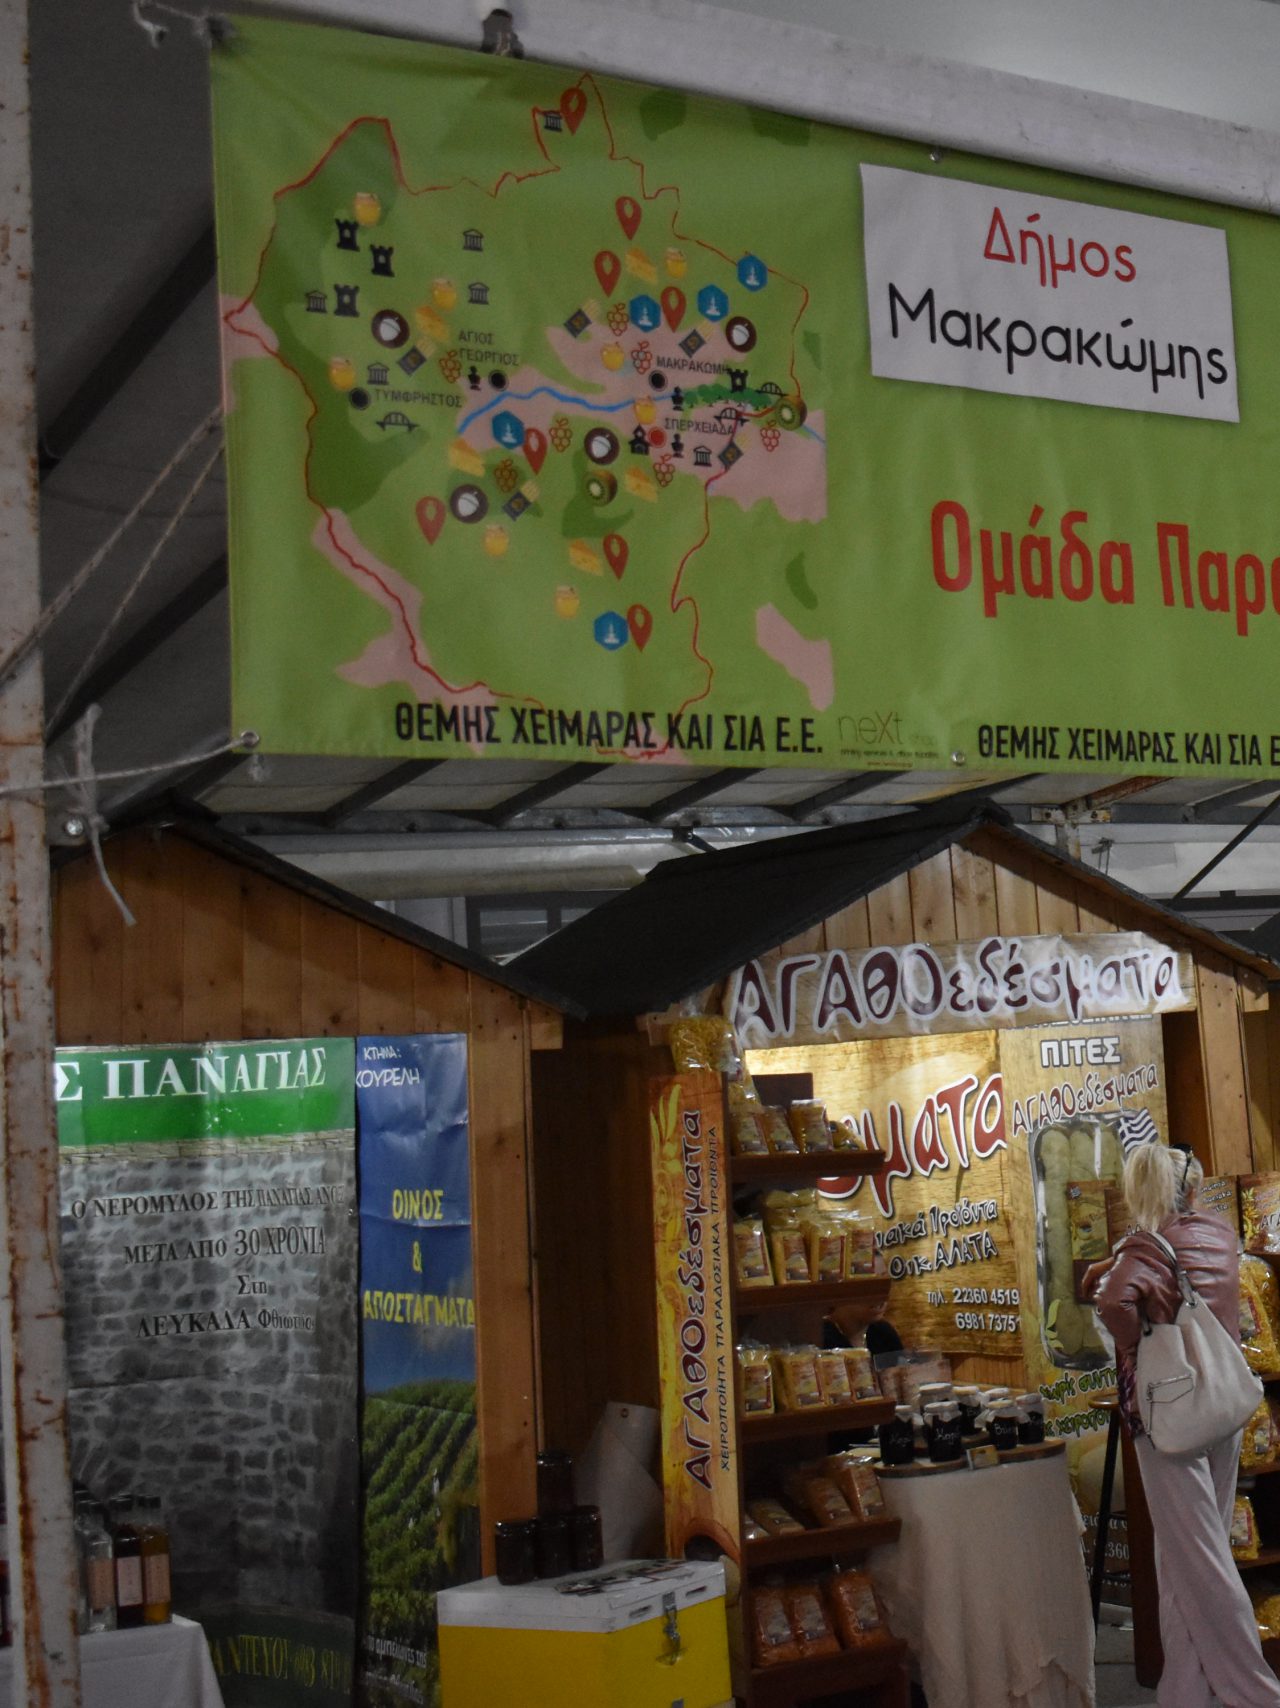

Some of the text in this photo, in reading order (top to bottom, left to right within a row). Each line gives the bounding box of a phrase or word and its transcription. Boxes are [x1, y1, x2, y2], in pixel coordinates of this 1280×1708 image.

[984, 205, 1136, 288] Δήμος
[459, 330, 493, 345] ΑΓΙΟΣ
[889, 282, 1227, 399] Μακρακώμης
[459, 349, 520, 366] ΓΕΩΡΓΙΟΣ
[374, 389, 462, 409] ΤΥΜΦΡΗΣΤΟΣ
[664, 417, 735, 435] ΣΠΕΡΧΕΙΑΔΑ
[930, 500, 1134, 618] Ομάδα
[395, 701, 822, 753] ΘΕΜΗΣ ΧΕΙΜΑΡΑΣ ΚΑΙ ΣΙΑ Ε.Ε.
[979, 725, 1058, 758] ΘΕΜΗΣ
[1068, 727, 1179, 763] ΧΕΙΜΑΡΑΣ
[1186, 732, 1221, 766] ΚΑΙ
[1229, 734, 1261, 766] ΣΙΑ
[1041, 1036, 1121, 1067] ΠΙΤΕΣ
[103, 1047, 327, 1099] ΠΑΝΑΓΙΑΣ
[1013, 1064, 1158, 1137] ΑΓΑΘΟεδέσματα
[71, 1200, 86, 1219] Ο
[92, 1191, 218, 1219] ΝΕΡΟΜΥΛΟΣ
[223, 1189, 258, 1210] ΤΗΣ
[392, 1189, 444, 1220] ΟΙΝΟΣ
[125, 1226, 326, 1264] ΜΕΤΑ ΑΠΟ 30 ΧΡΟΝΙΑ
[237, 1275, 268, 1296] Στη
[678, 1110, 712, 1490] ΑΓΑΘΟεδέσματα
[953, 1288, 988, 1305] 22360
[362, 1290, 475, 1328] ΑΠΟΣΤΑΓΜΑΤΑ
[955, 1313, 986, 1330] 6981
[137, 1310, 252, 1340] ΛΕΥΚΑΔΑ
